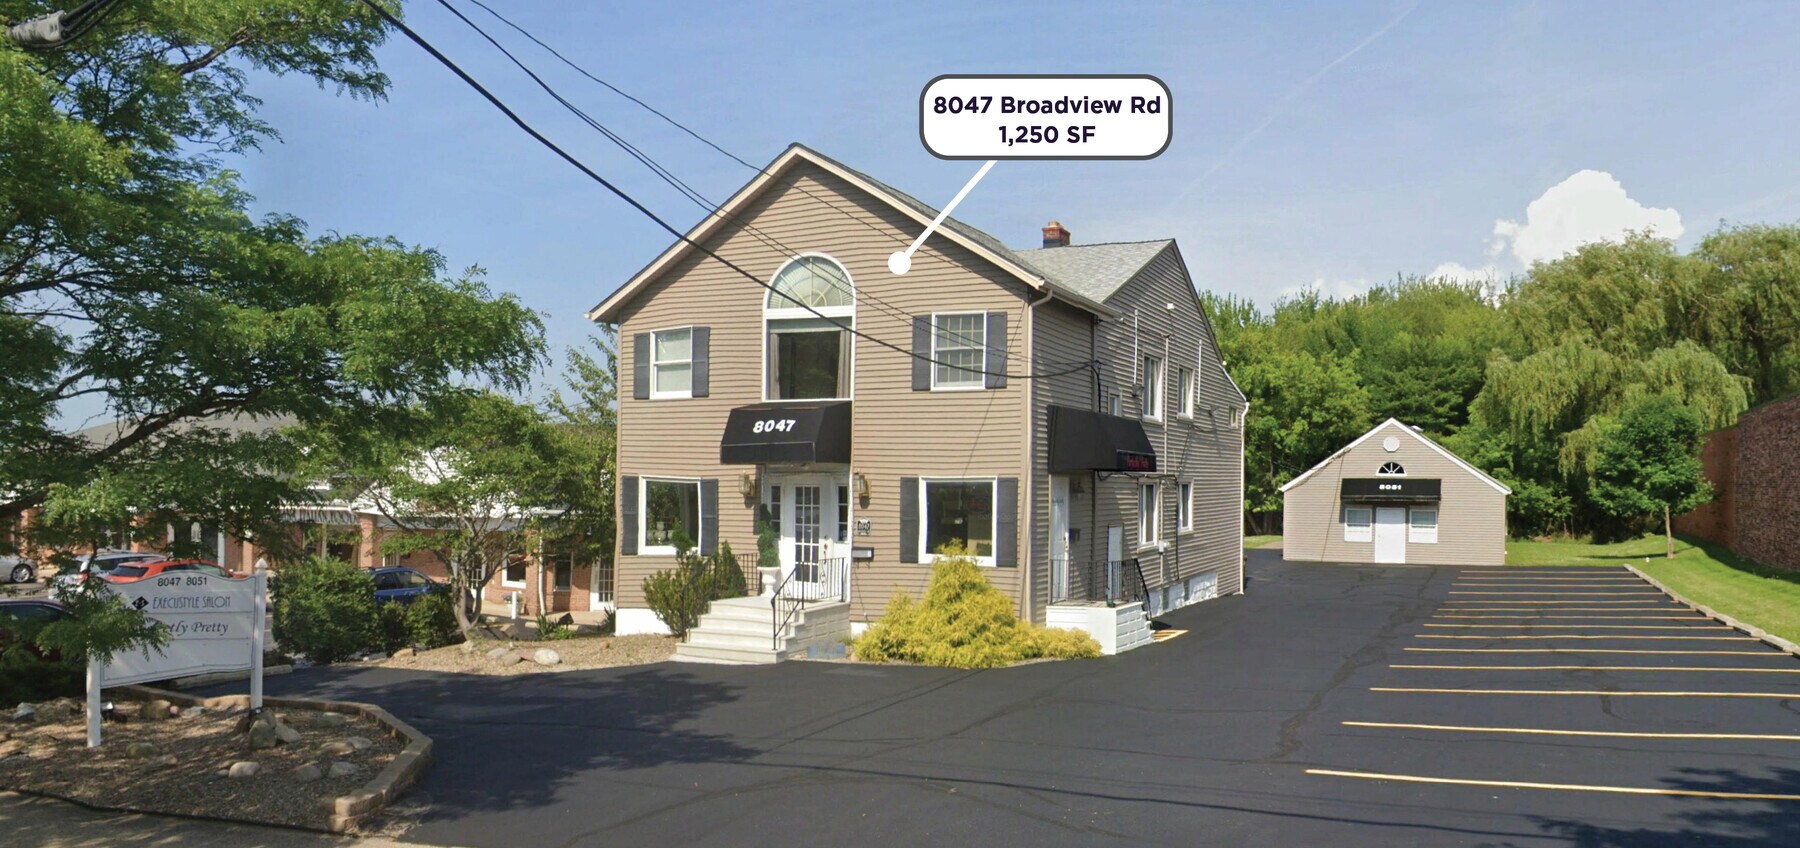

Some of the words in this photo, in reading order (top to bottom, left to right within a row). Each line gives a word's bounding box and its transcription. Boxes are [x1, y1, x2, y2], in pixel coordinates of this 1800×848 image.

[752, 419, 796, 434] 8047
[157, 577, 180, 587] 8047
[186, 576, 207, 586] 8051
[152, 596, 199, 609] EXECUSTYLE
[202, 595, 231, 608] SALON
[191, 621, 229, 636] Pretty
